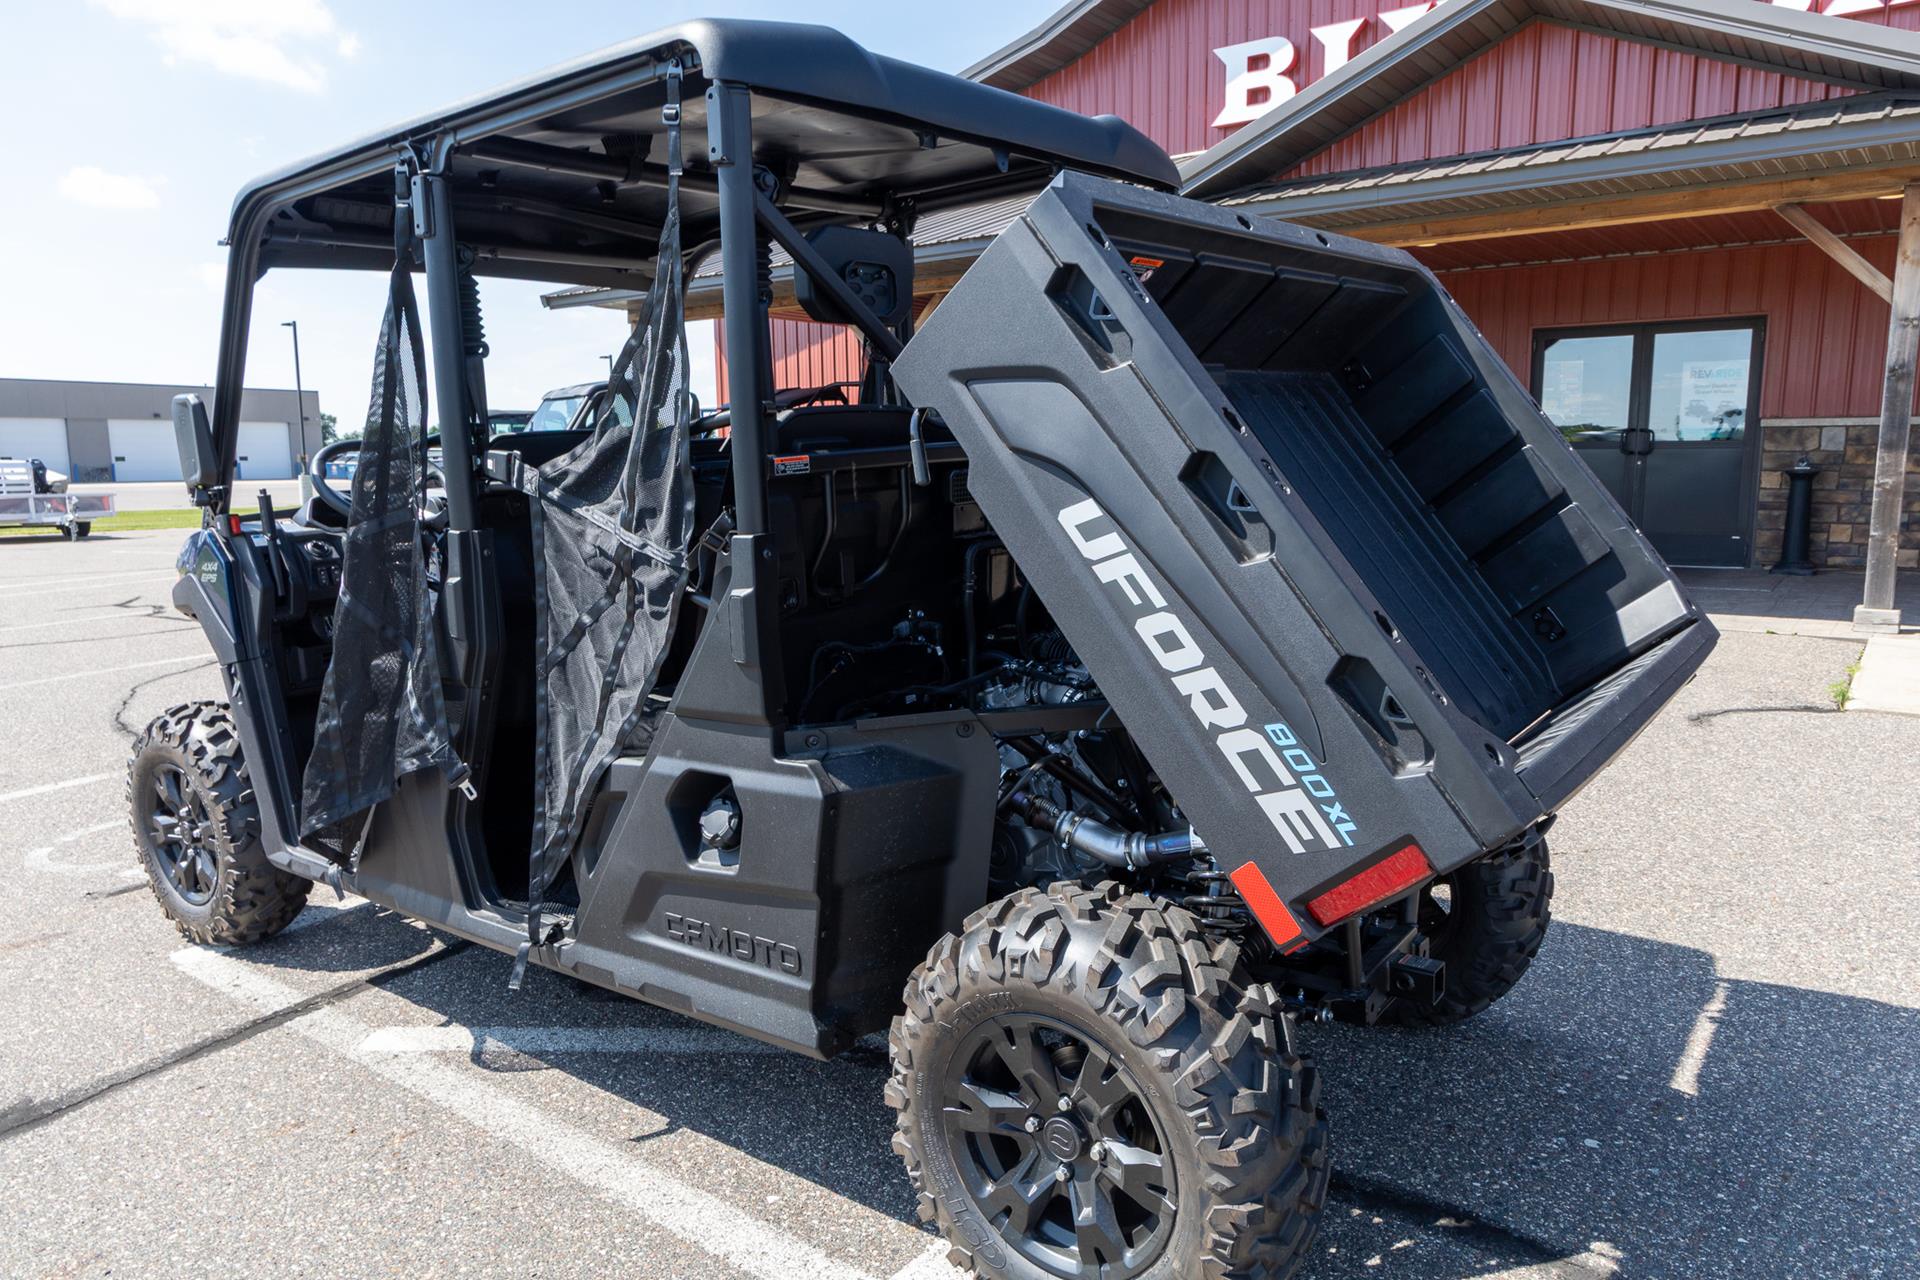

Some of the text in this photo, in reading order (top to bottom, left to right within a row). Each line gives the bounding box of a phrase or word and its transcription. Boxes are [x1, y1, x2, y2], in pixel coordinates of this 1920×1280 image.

[201, 573, 218, 583] EPS
[1058, 498, 1342, 855] UFORCE
[665, 911, 802, 976] CFMOTO
